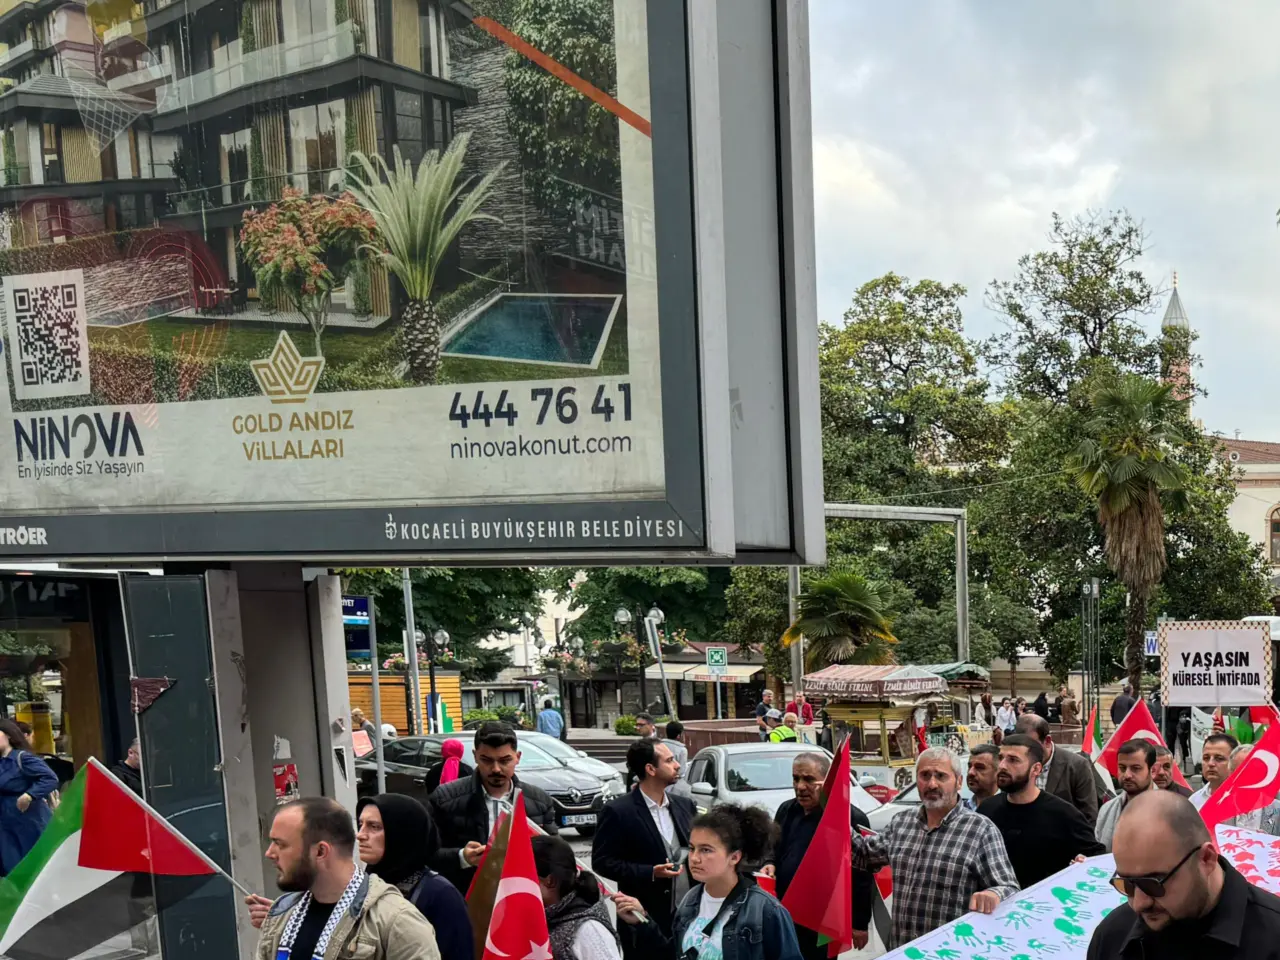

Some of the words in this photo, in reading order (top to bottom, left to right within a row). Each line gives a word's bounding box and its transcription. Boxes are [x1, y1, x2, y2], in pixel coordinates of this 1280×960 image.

[448, 389, 518, 429] 444
[531, 386, 579, 426] 76
[591, 382, 632, 423] 41
[232, 412, 283, 435] GOLD
[288, 409, 354, 433] ANDIZ
[450, 434, 632, 459] ninovakonut.com
[18, 464, 31, 479] En
[34, 460, 74, 480] İyisinde
[75, 460, 93, 474] Siz
[96, 460, 144, 478] Yaşayın
[401, 518, 466, 540] KOCAELİ
[1181, 651, 1250, 672] YAŞASIN
[1172, 670, 1214, 687] KÜRESEL
[1216, 669, 1260, 686] İNTİFADA
